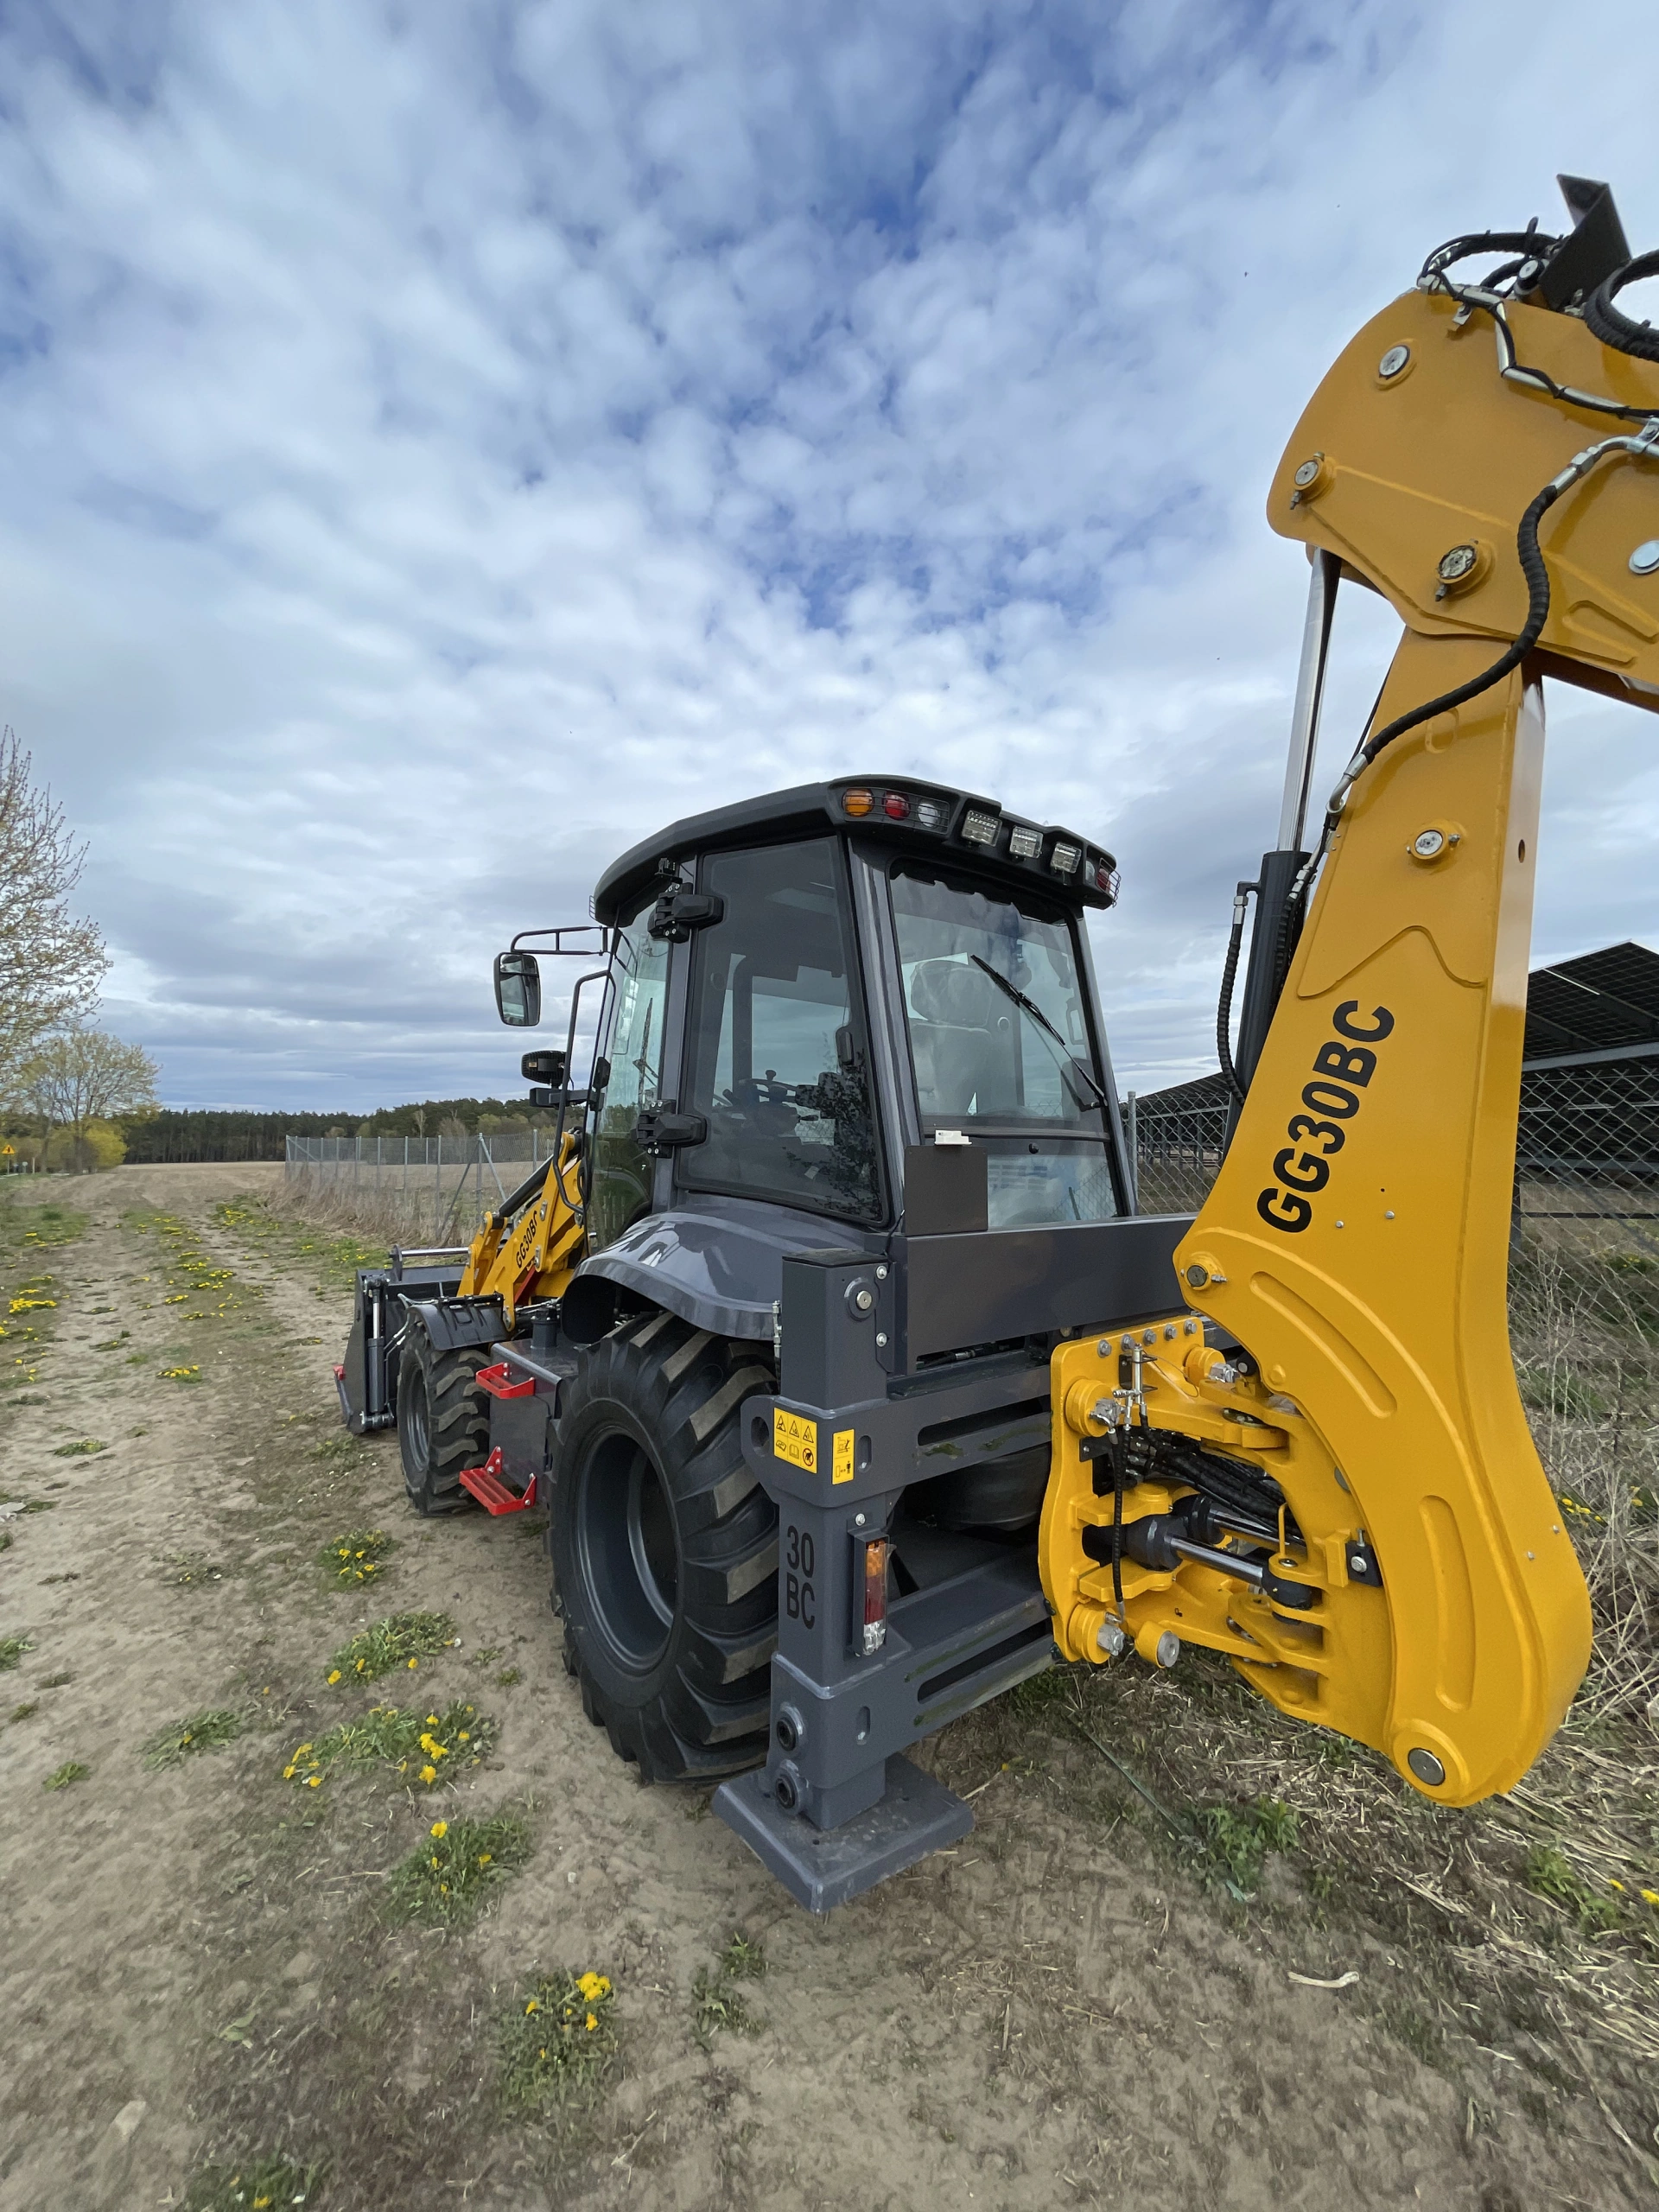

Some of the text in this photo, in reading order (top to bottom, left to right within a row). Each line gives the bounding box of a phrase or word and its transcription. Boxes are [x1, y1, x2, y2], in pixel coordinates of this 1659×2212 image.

[1256, 1000, 1395, 1233] GG30BC
[786, 1525, 815, 1578] 30
[786, 1572, 816, 1630] BC
